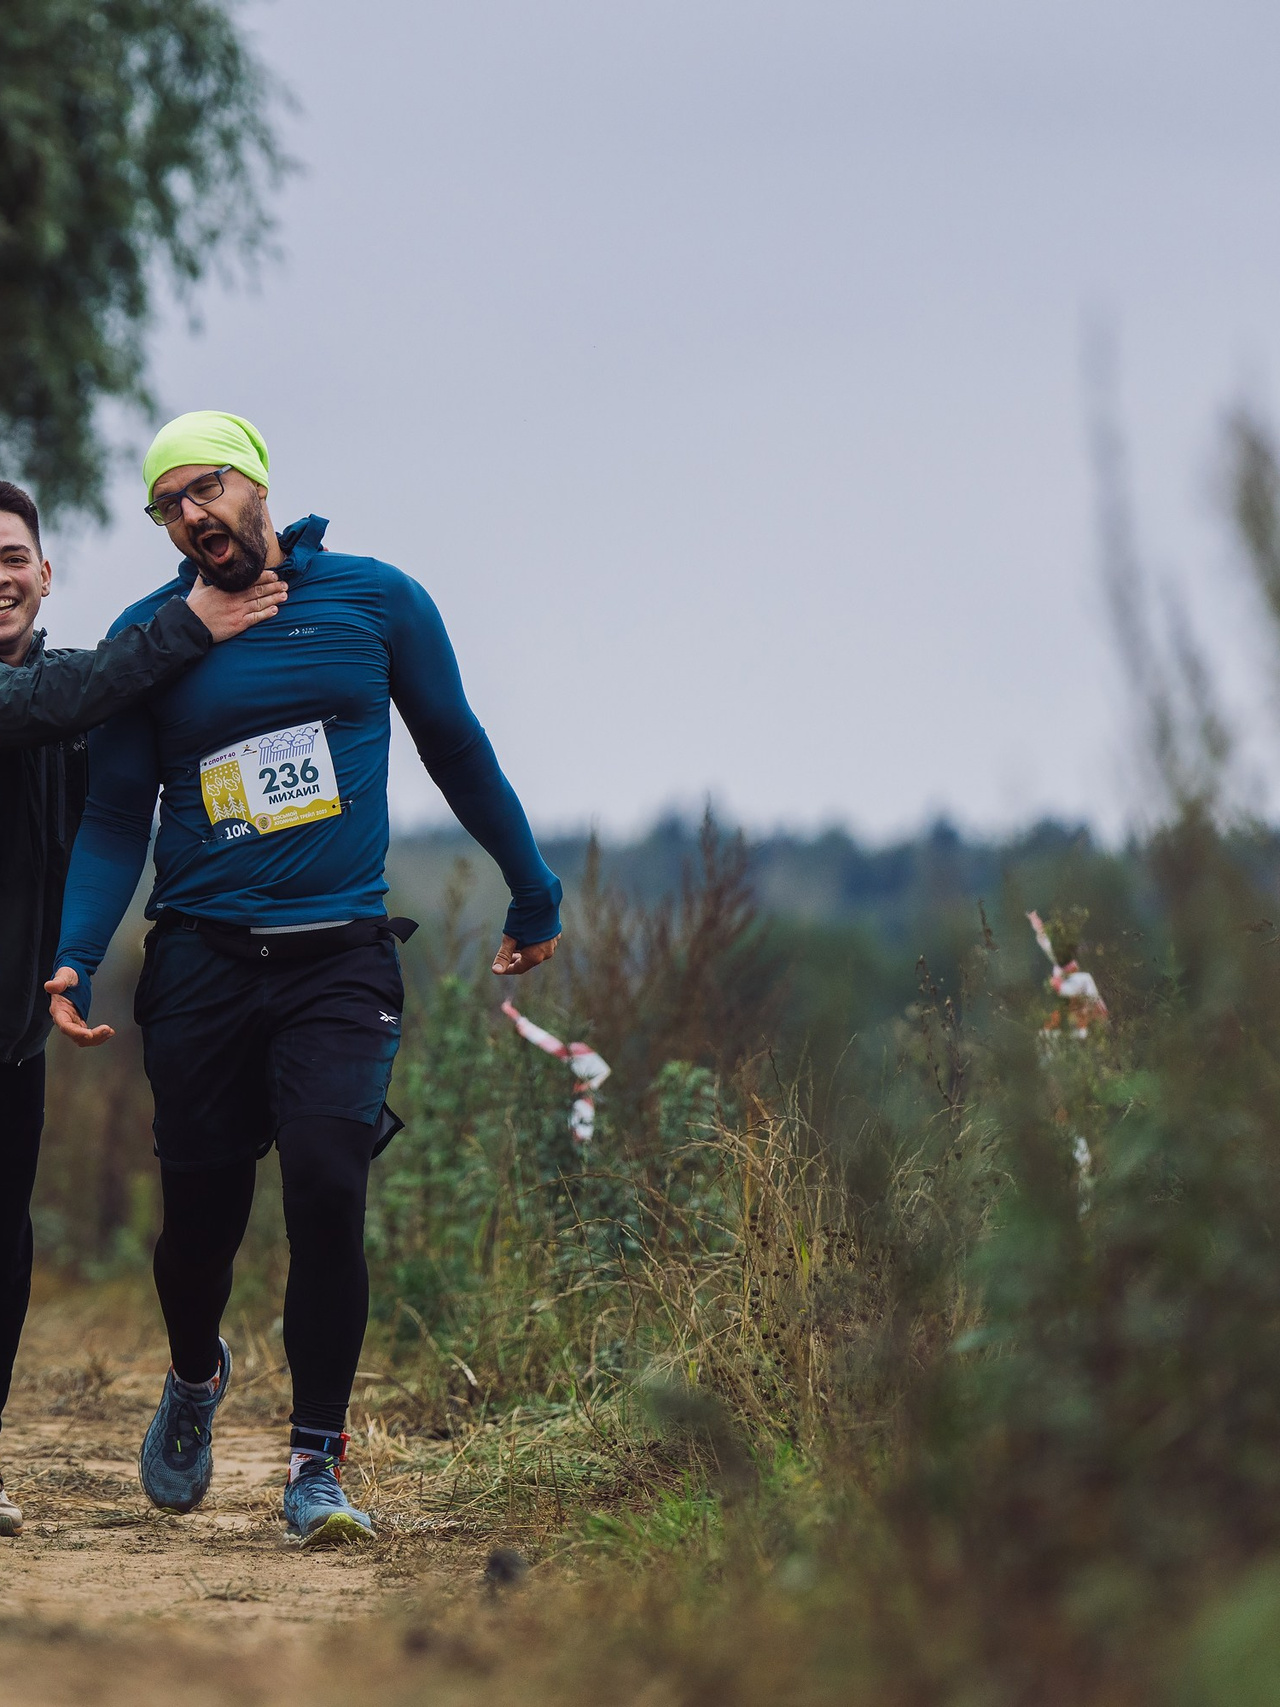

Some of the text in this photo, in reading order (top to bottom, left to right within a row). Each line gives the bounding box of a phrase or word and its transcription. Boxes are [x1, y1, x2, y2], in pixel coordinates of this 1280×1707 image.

[208, 754, 227, 765] СПОРТ
[258, 758, 320, 795] 236
[268, 784, 320, 805] МИХАИЛ
[273, 810, 298, 821] ВОСЬМОЙ
[225, 822, 251, 840] 10K
